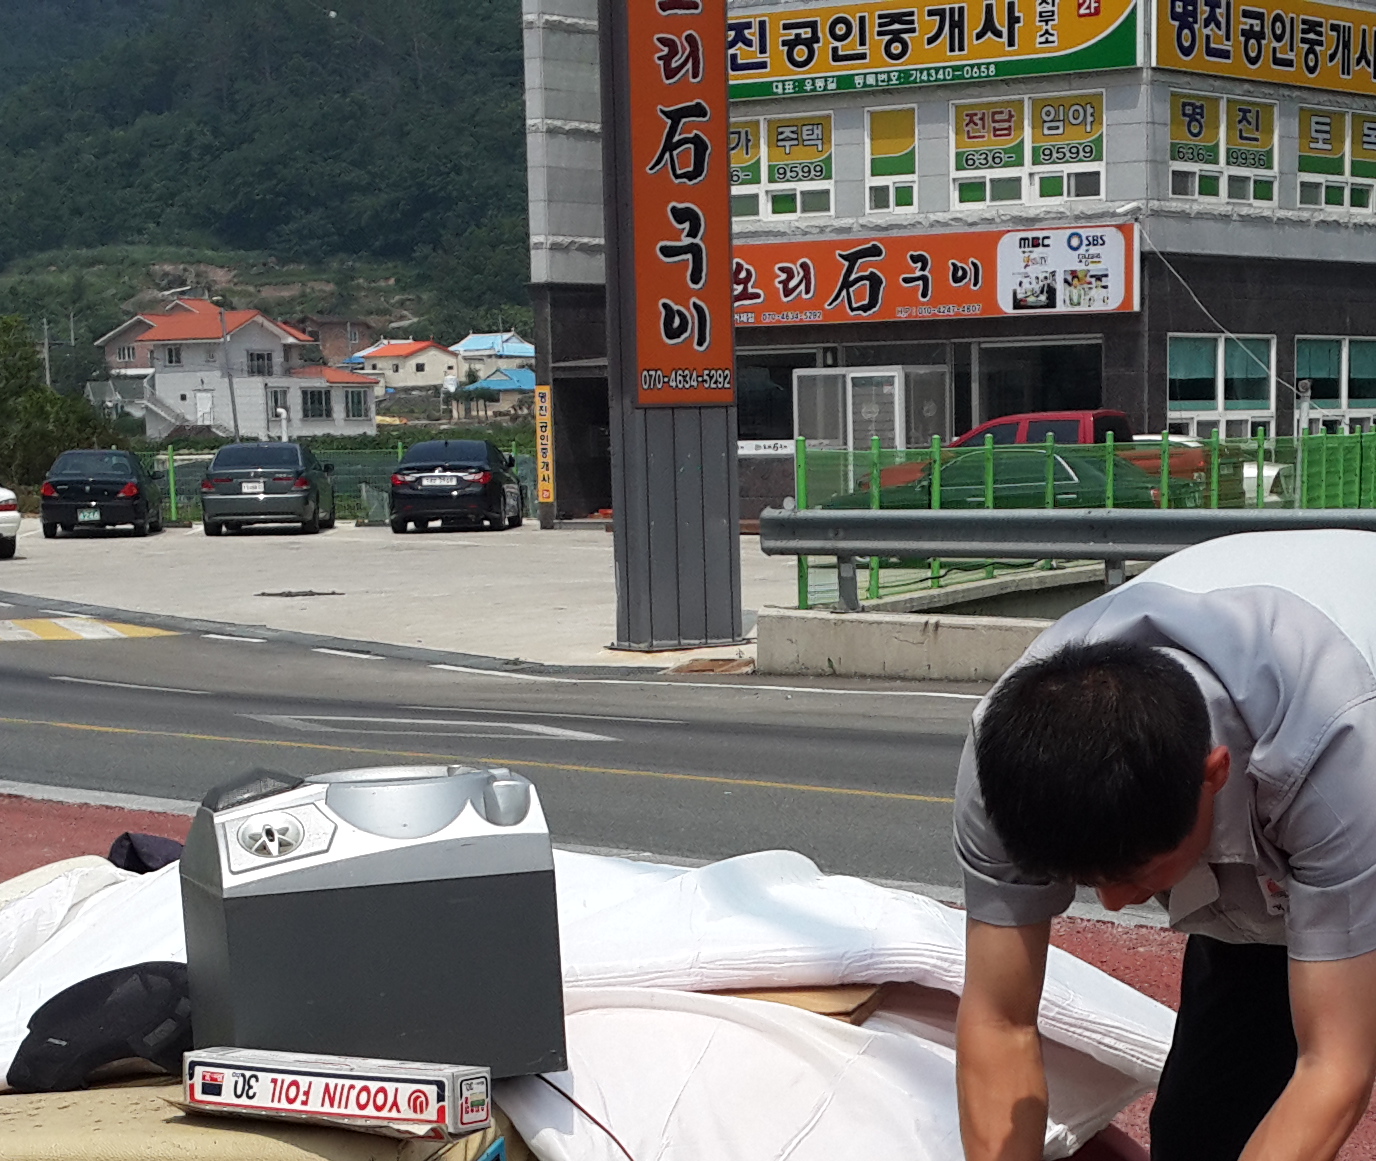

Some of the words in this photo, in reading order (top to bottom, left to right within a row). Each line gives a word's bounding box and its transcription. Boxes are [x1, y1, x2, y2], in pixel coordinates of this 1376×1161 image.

[963, 108, 1015, 141] 전답
[1040, 103, 1095, 136] 임야
[1181, 100, 1206, 140] 명
[1237, 106, 1261, 143] 진
[1309, 115, 1333, 152] 토
[776, 124, 824, 155] 주택
[964, 150, 1015, 168] 636-
[1040, 145, 1095, 163] 9599
[1176, 147, 1214, 163] 636-
[1229, 150, 1267, 168] 9936
[776, 163, 825, 182] 9599
[1018, 235, 1051, 249] MBC
[1085, 234, 1107, 247] SBS
[642, 369, 731, 390] 070-4634-5292
[232, 1072, 260, 1100] 30
[269, 1077, 312, 1105] FOIL
[322, 1078, 402, 1114] YOOJIN
